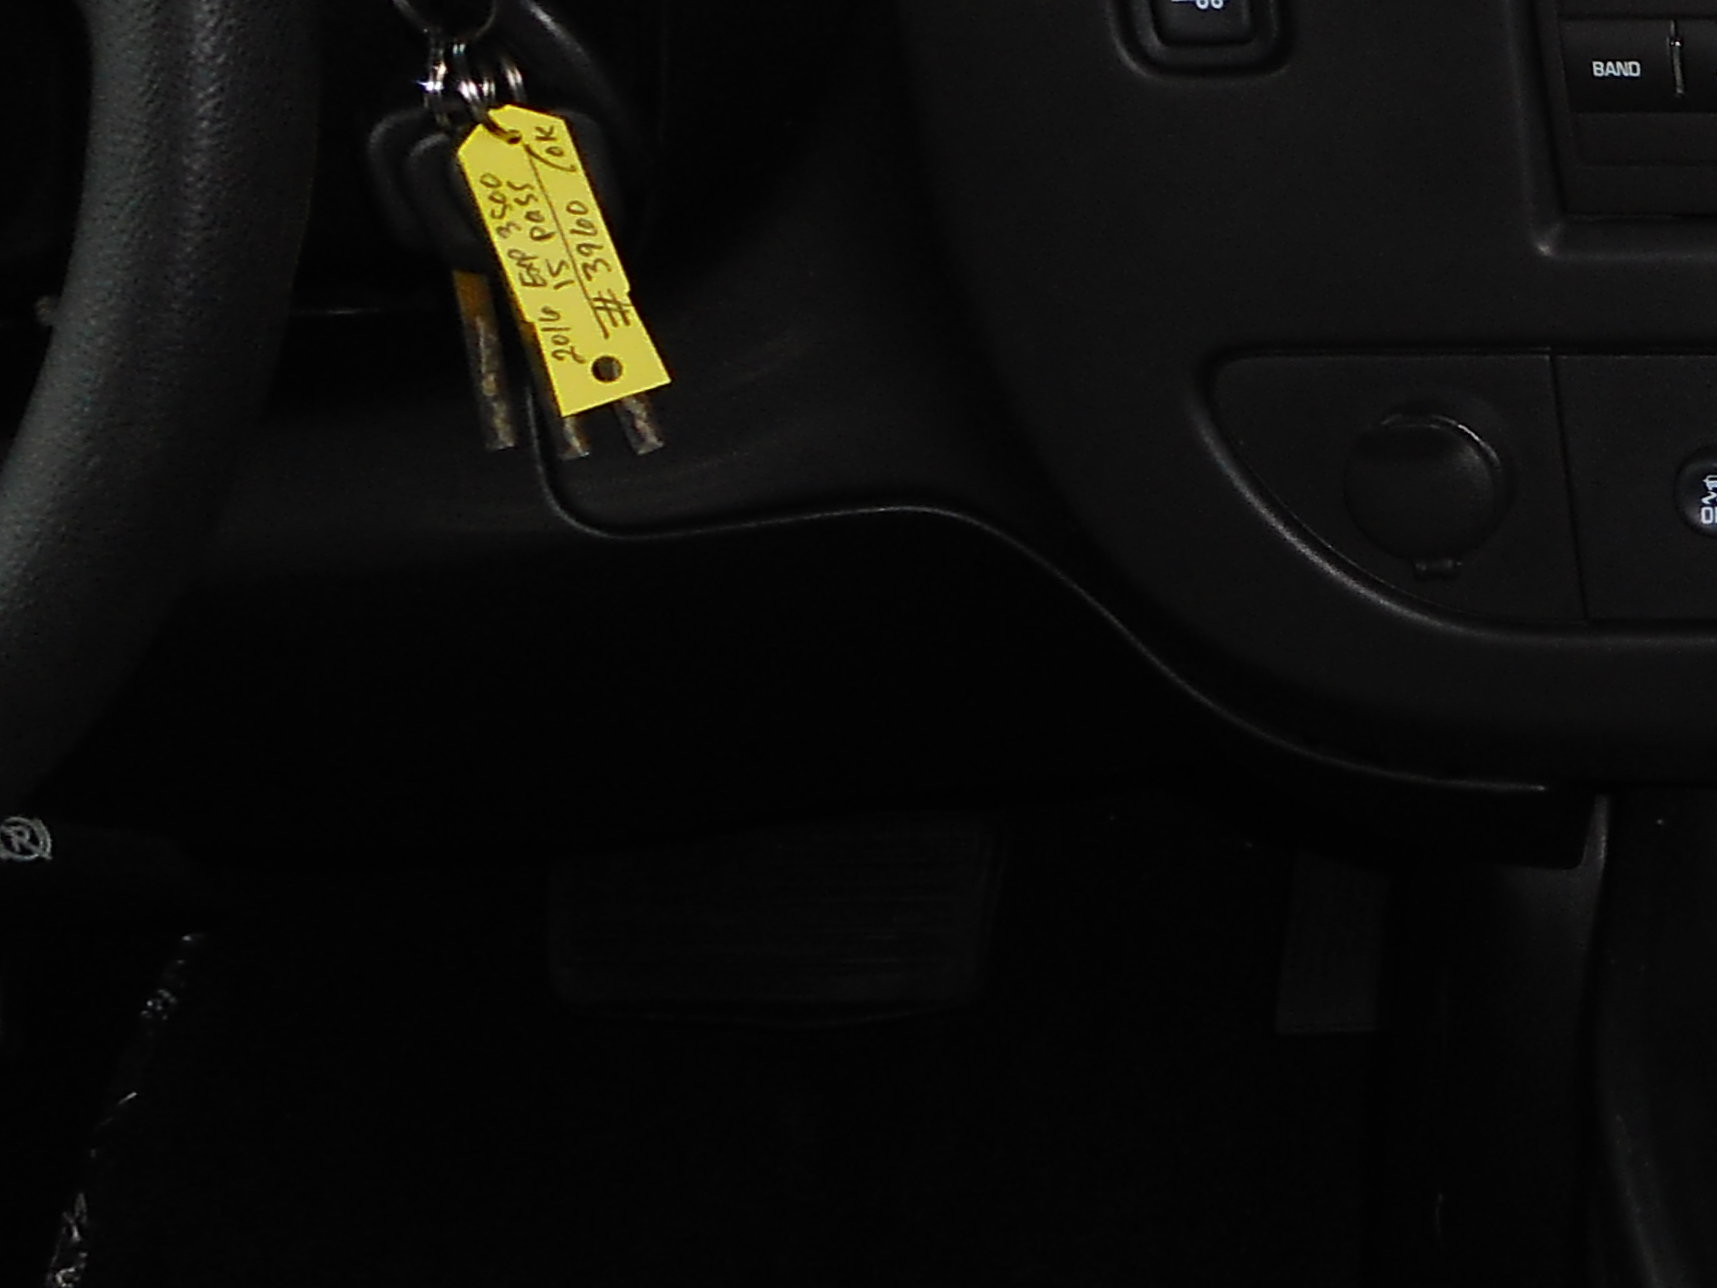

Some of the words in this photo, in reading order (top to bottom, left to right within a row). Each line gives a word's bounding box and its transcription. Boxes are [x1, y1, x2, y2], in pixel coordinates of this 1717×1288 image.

[1592, 60, 1641, 77] BAND
[478, 171, 523, 240] 3500
[545, 258, 576, 291] 15
[538, 304, 588, 365] 2016
